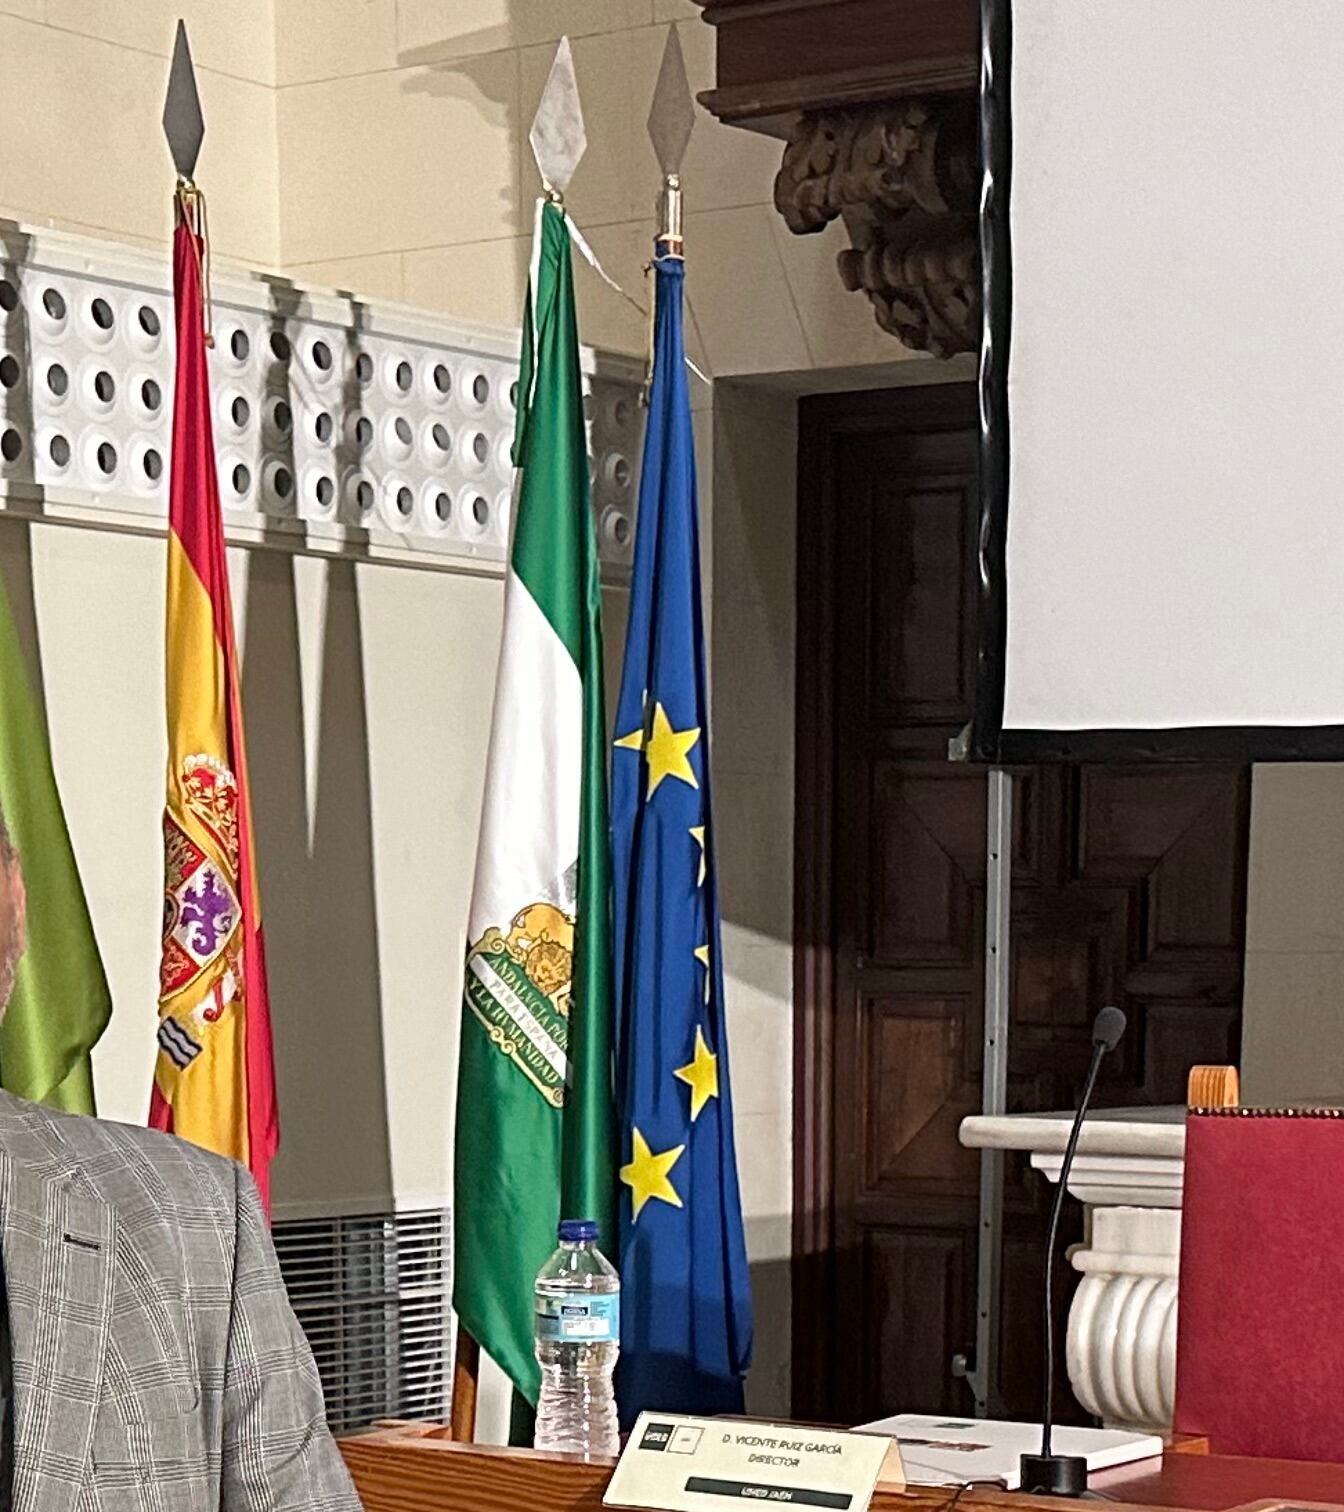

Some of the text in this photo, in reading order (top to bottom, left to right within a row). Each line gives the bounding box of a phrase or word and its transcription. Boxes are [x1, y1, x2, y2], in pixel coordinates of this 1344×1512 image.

[736, 1435, 778, 1448] VICENTE
[778, 1440, 804, 1452] RUIZ
[805, 1443, 842, 1455] GARCÍA
[748, 1454, 800, 1467] DIRECTOR
